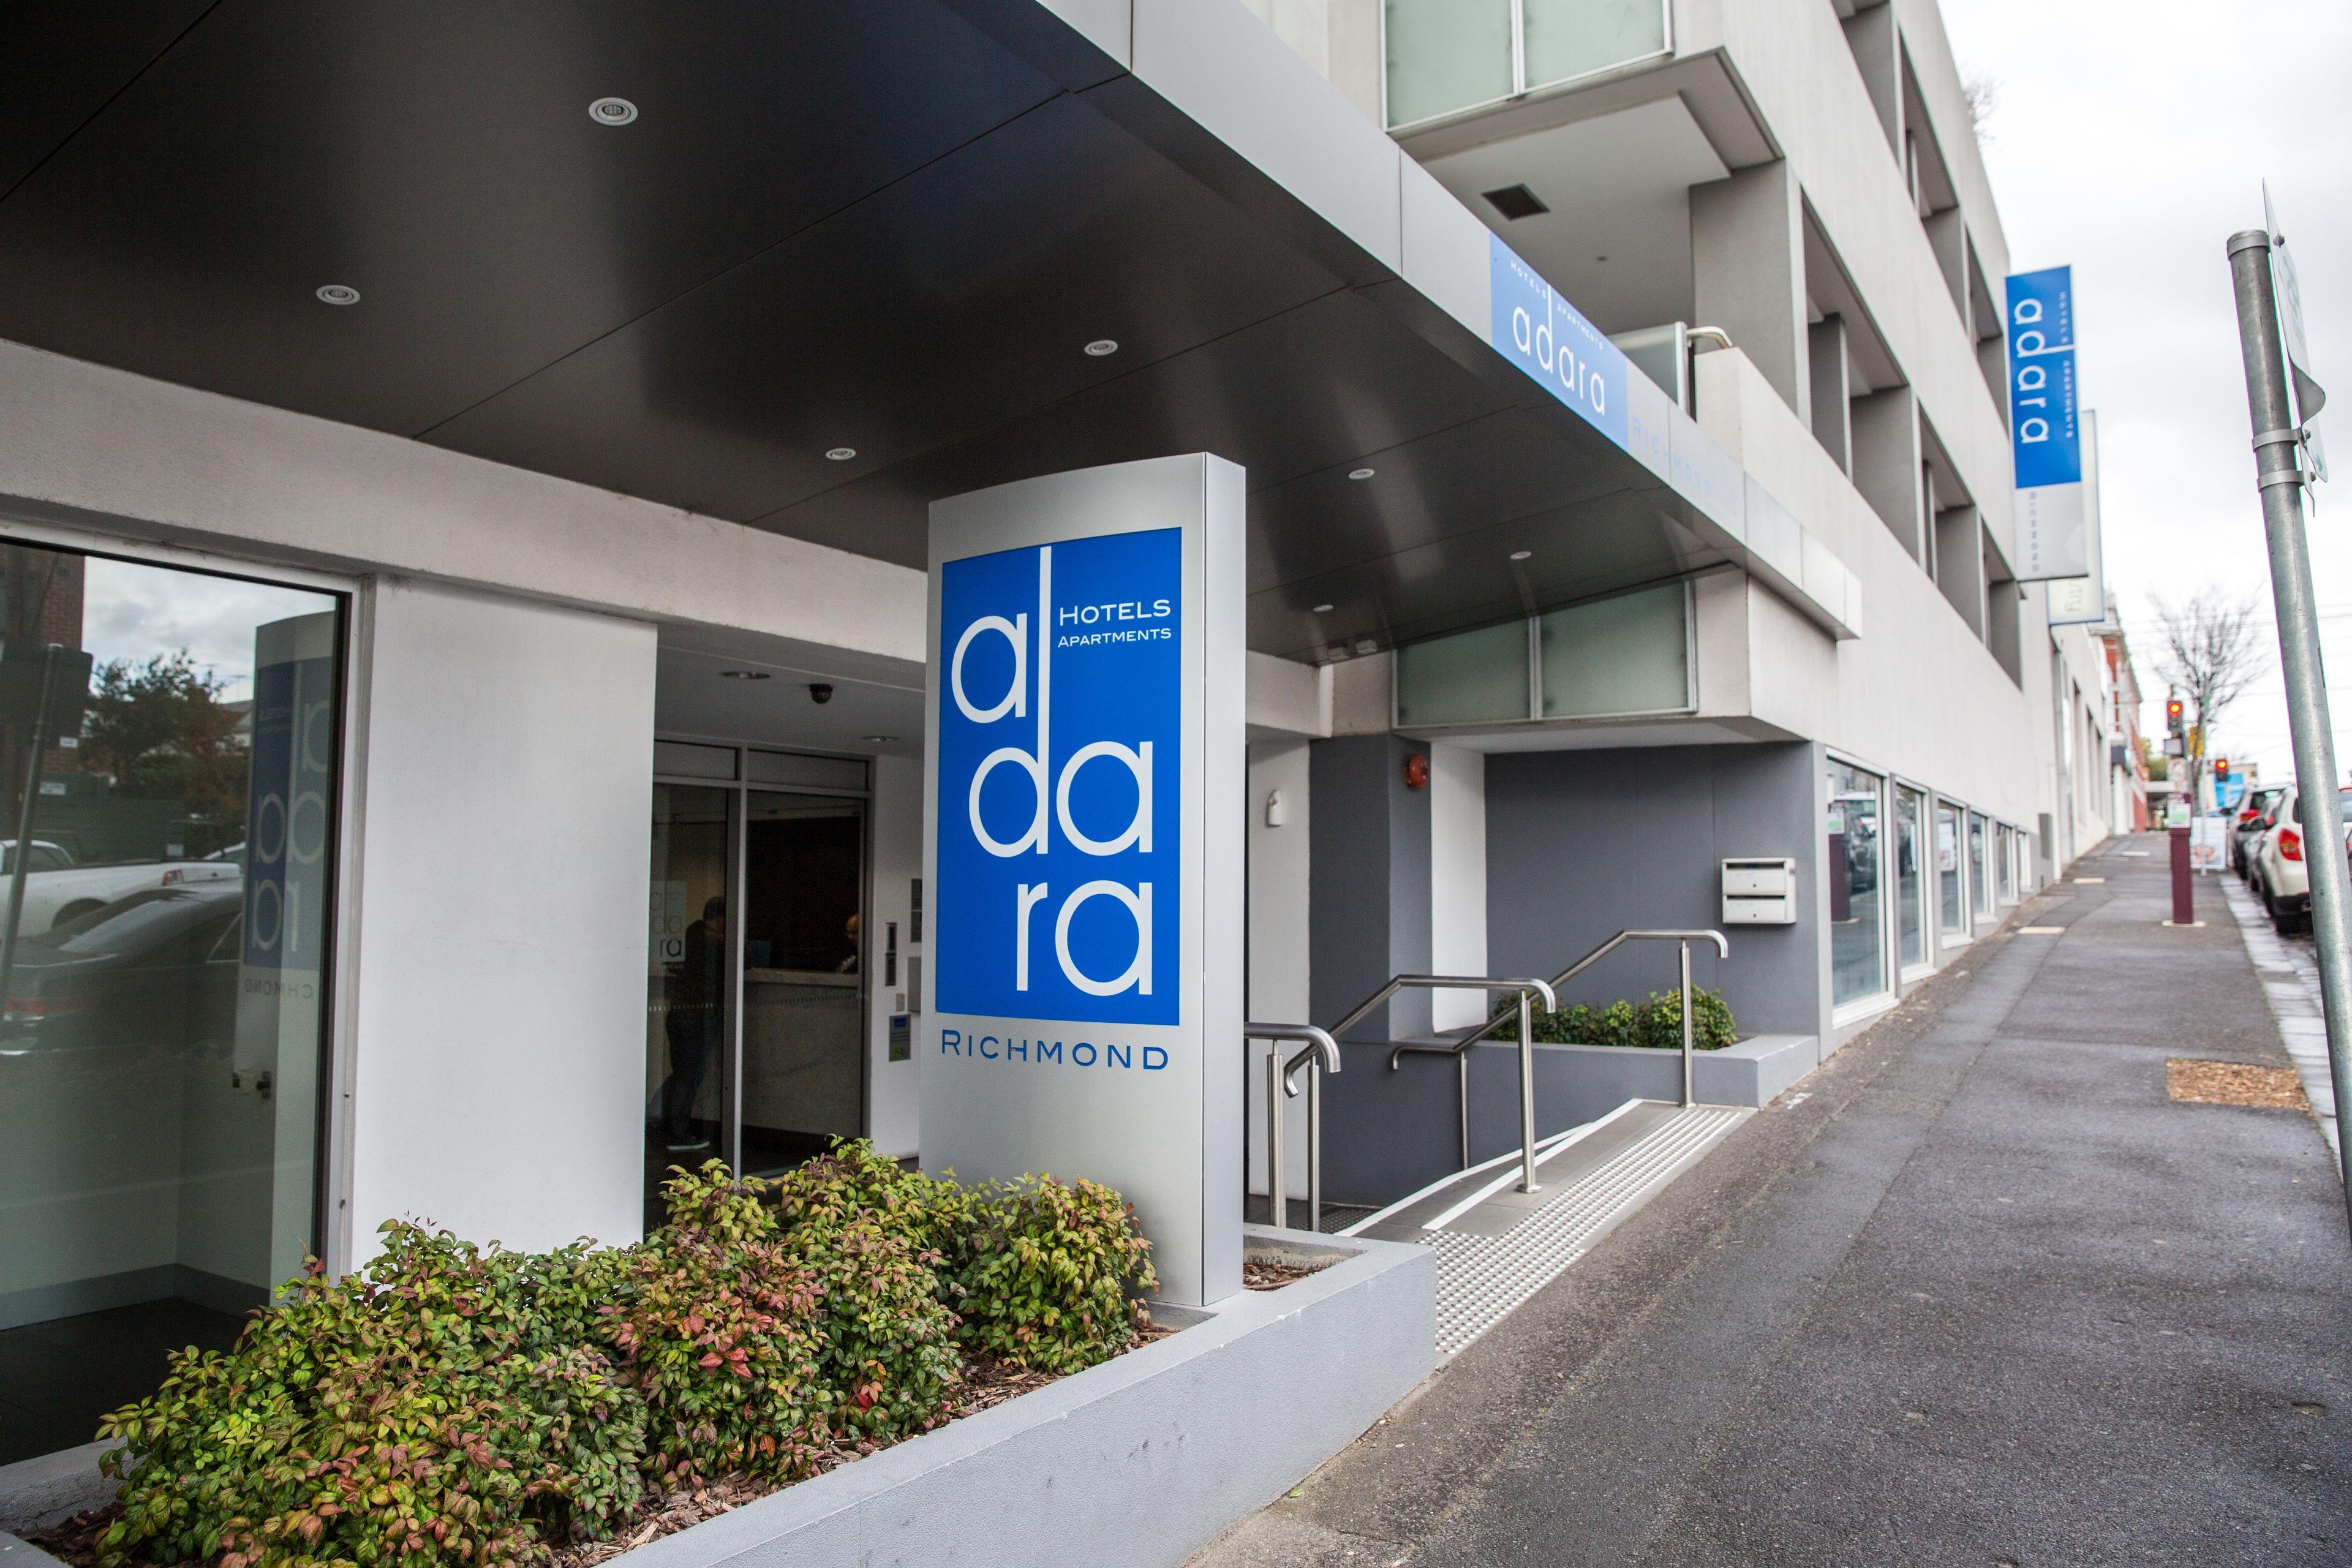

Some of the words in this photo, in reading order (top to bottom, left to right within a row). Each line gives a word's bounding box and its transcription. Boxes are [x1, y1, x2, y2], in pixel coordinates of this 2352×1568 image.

[1510, 260, 1547, 299] HOTELS
[1557, 303, 1604, 352] APARTMENTS
[1512, 284, 1605, 417] adara
[2014, 298, 2075, 443] adara
[1632, 414, 1711, 499] RICHMOND
[1058, 628, 1172, 648] APARTMENTS
[1060, 599, 1171, 626] HOTELS
[942, 1029, 1168, 1070] RICHMOND
